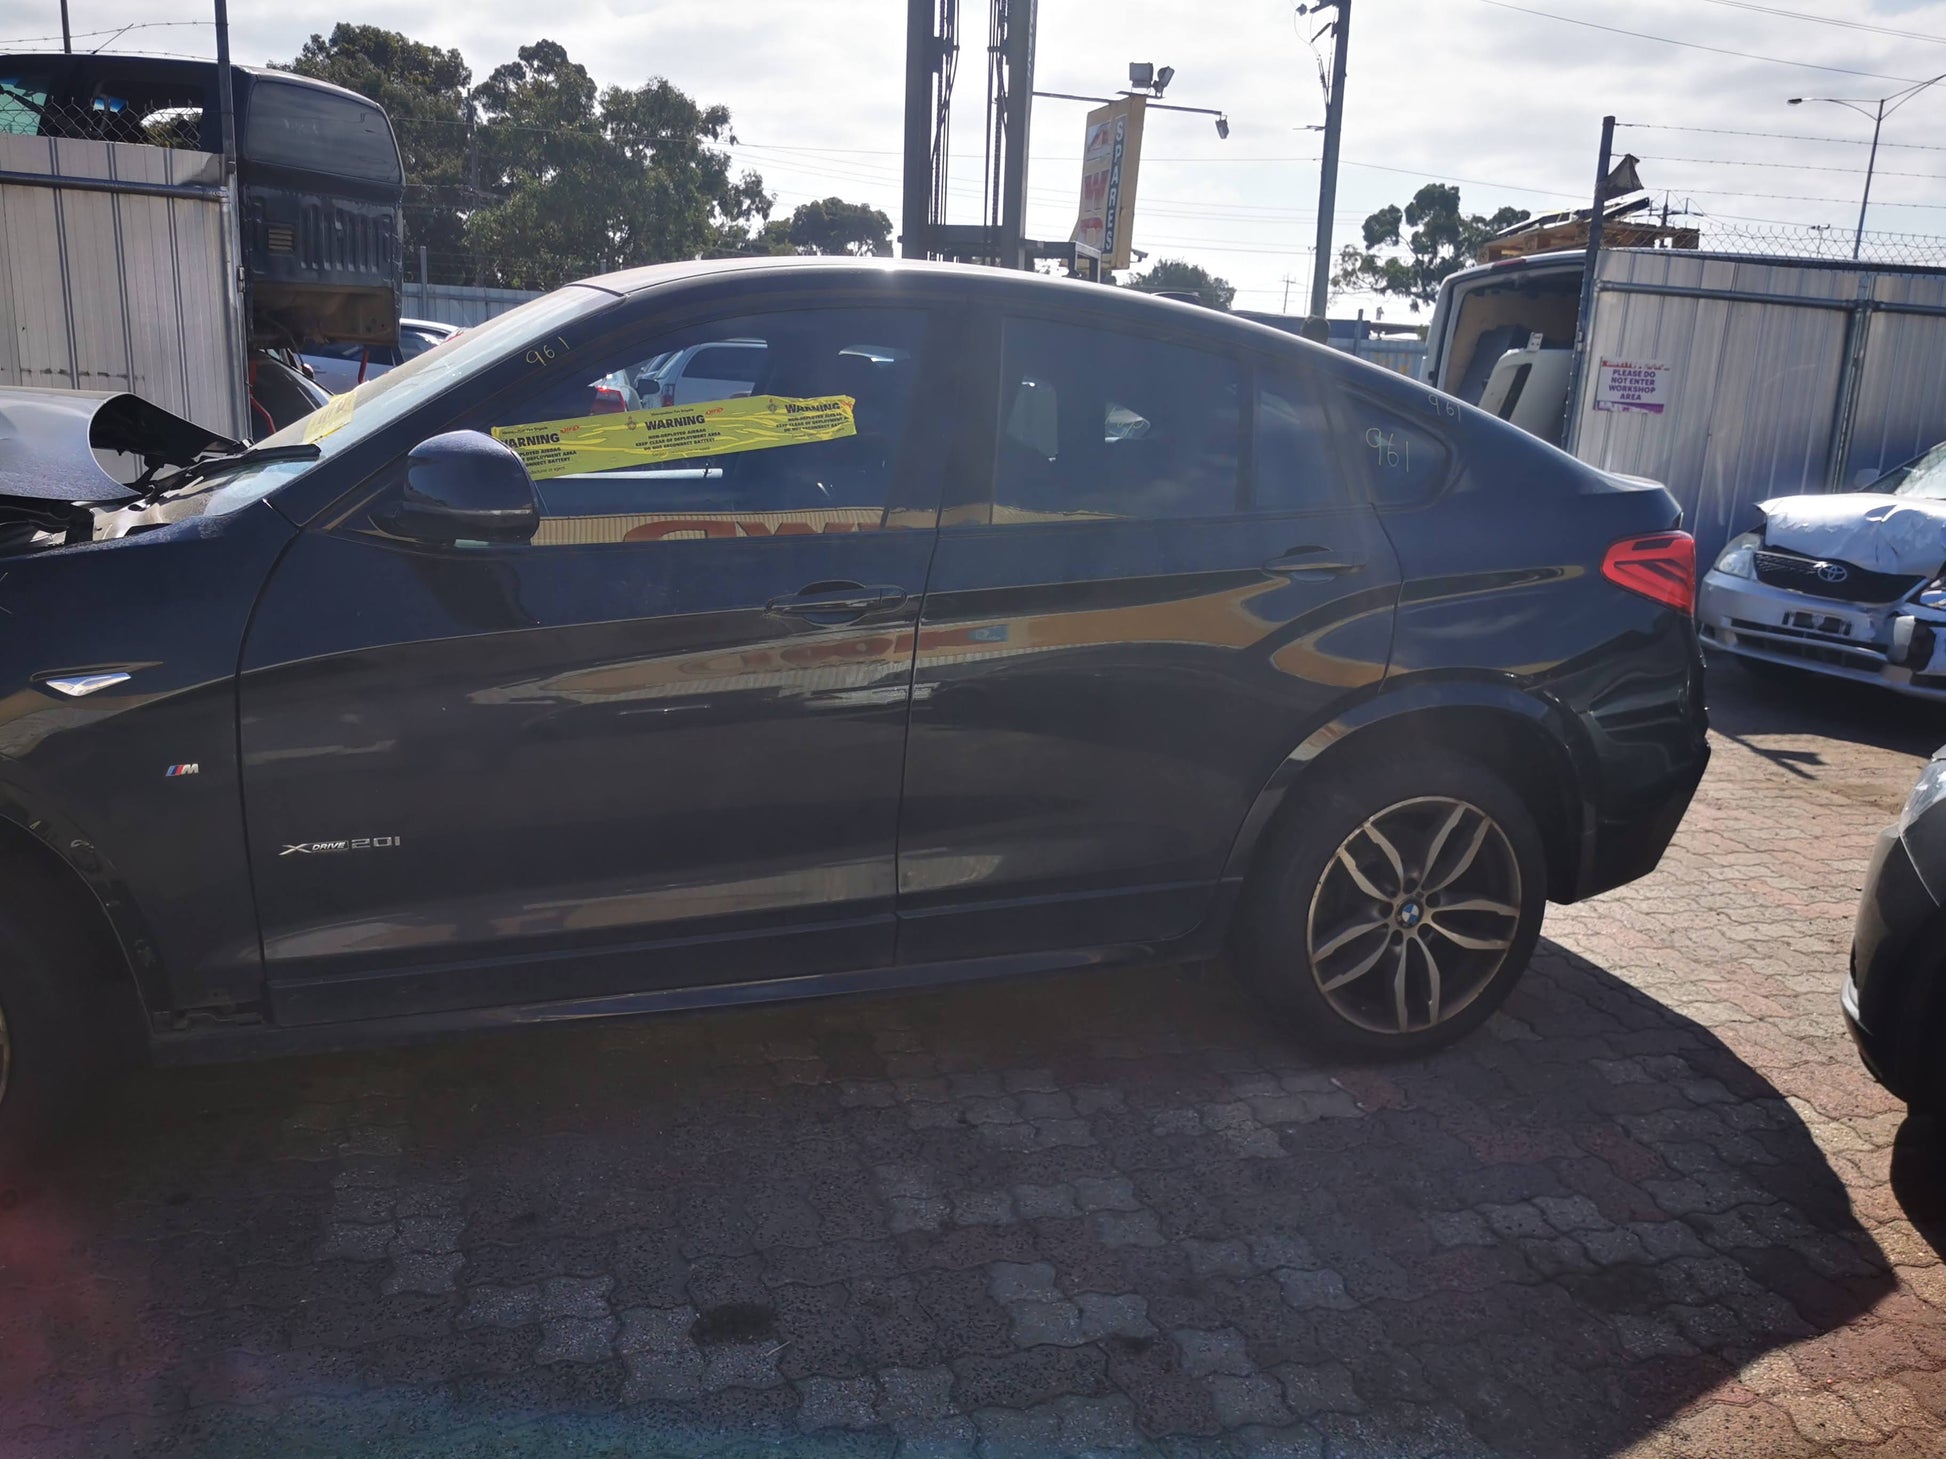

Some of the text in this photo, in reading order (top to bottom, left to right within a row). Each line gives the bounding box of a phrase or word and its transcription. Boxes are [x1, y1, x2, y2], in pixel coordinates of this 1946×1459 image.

[1105, 121, 1124, 250] SPARES
[526, 336, 570, 366] 961
[1612, 369, 1642, 377] PLEASE
[1608, 385, 1656, 394] WORKSHOP
[1610, 377, 1655, 386] NOT ENTER
[784, 402, 840, 414] WARNING
[1428, 394, 1461, 424] 961
[645, 415, 706, 431] WARNING
[1366, 428, 1409, 473] 961
